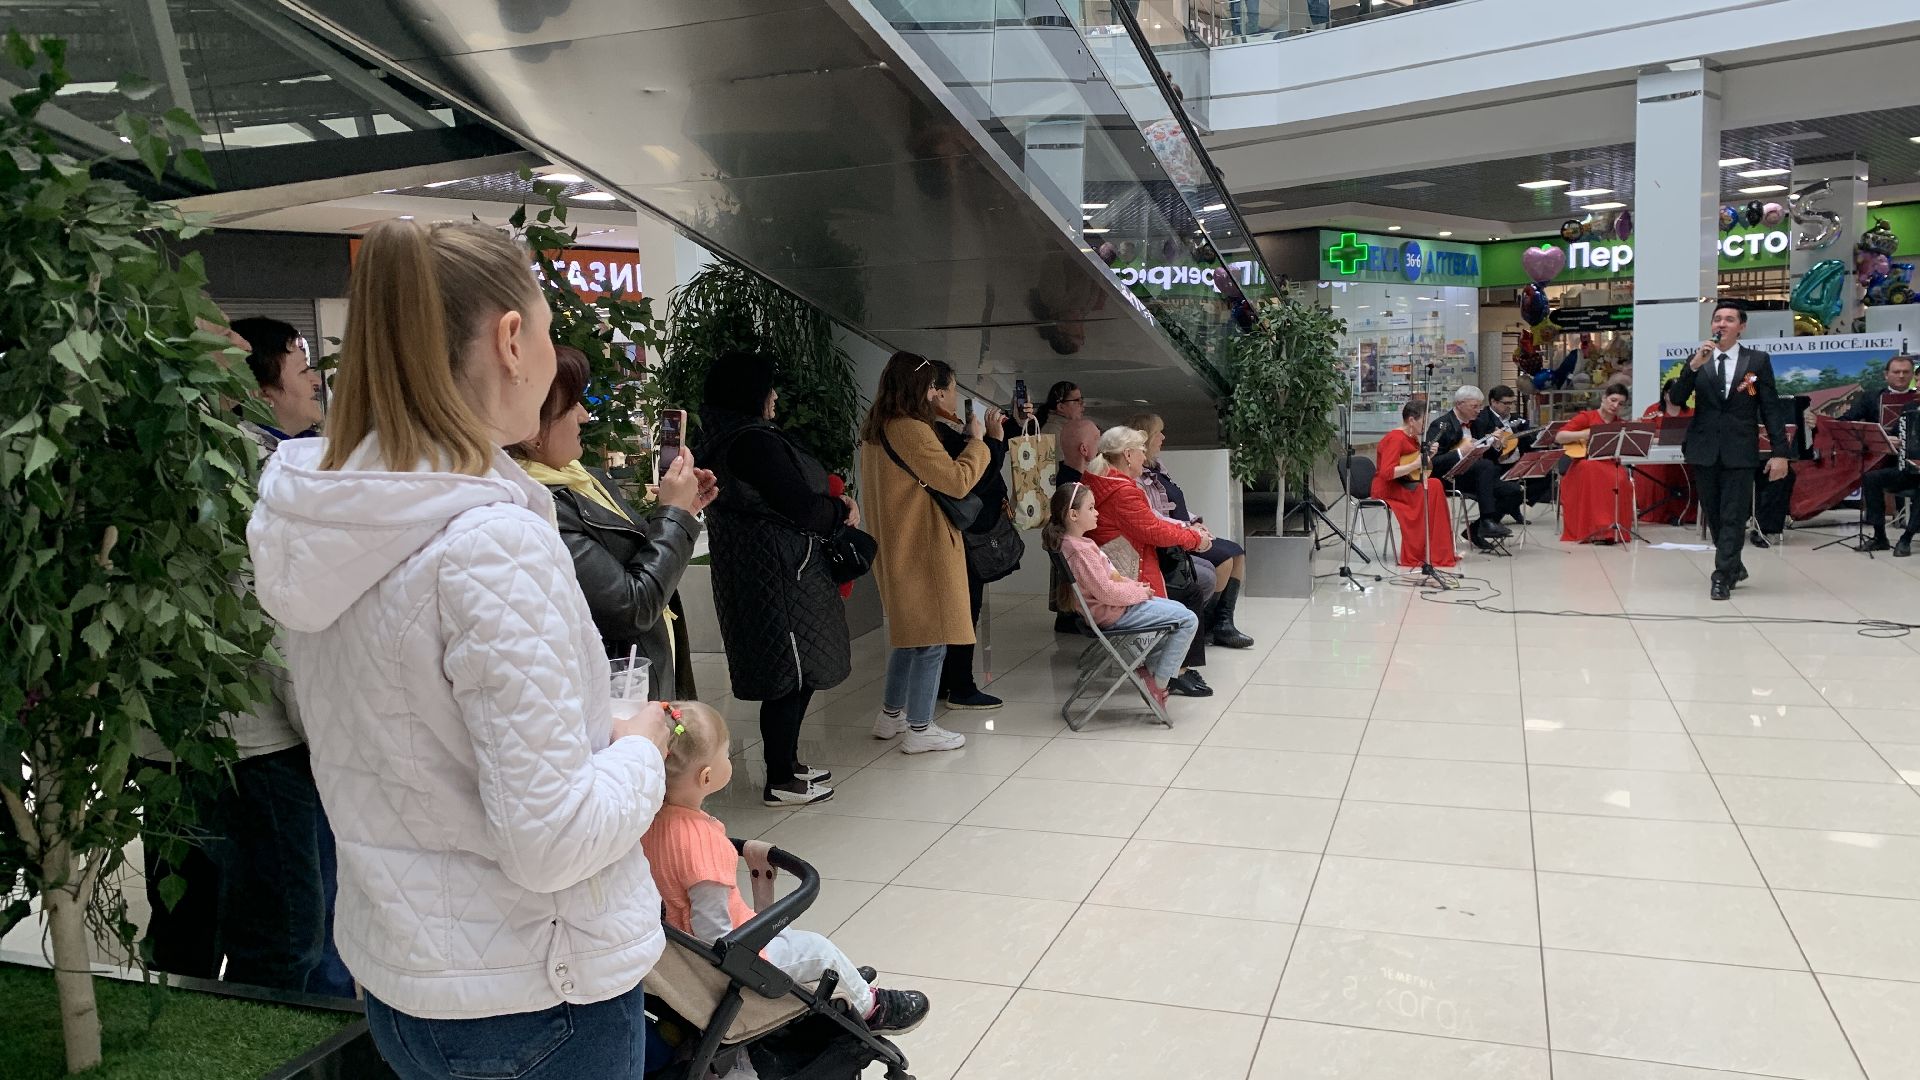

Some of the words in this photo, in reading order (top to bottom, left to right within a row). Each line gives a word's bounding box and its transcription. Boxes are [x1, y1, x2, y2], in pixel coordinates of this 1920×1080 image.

[1425, 250, 1479, 276] АПТЕКА
[1765, 343, 1803, 353] ДОМА
[1808, 342, 1817, 351] В
[1820, 337, 1893, 351] ПОСЁЛКЕ!
